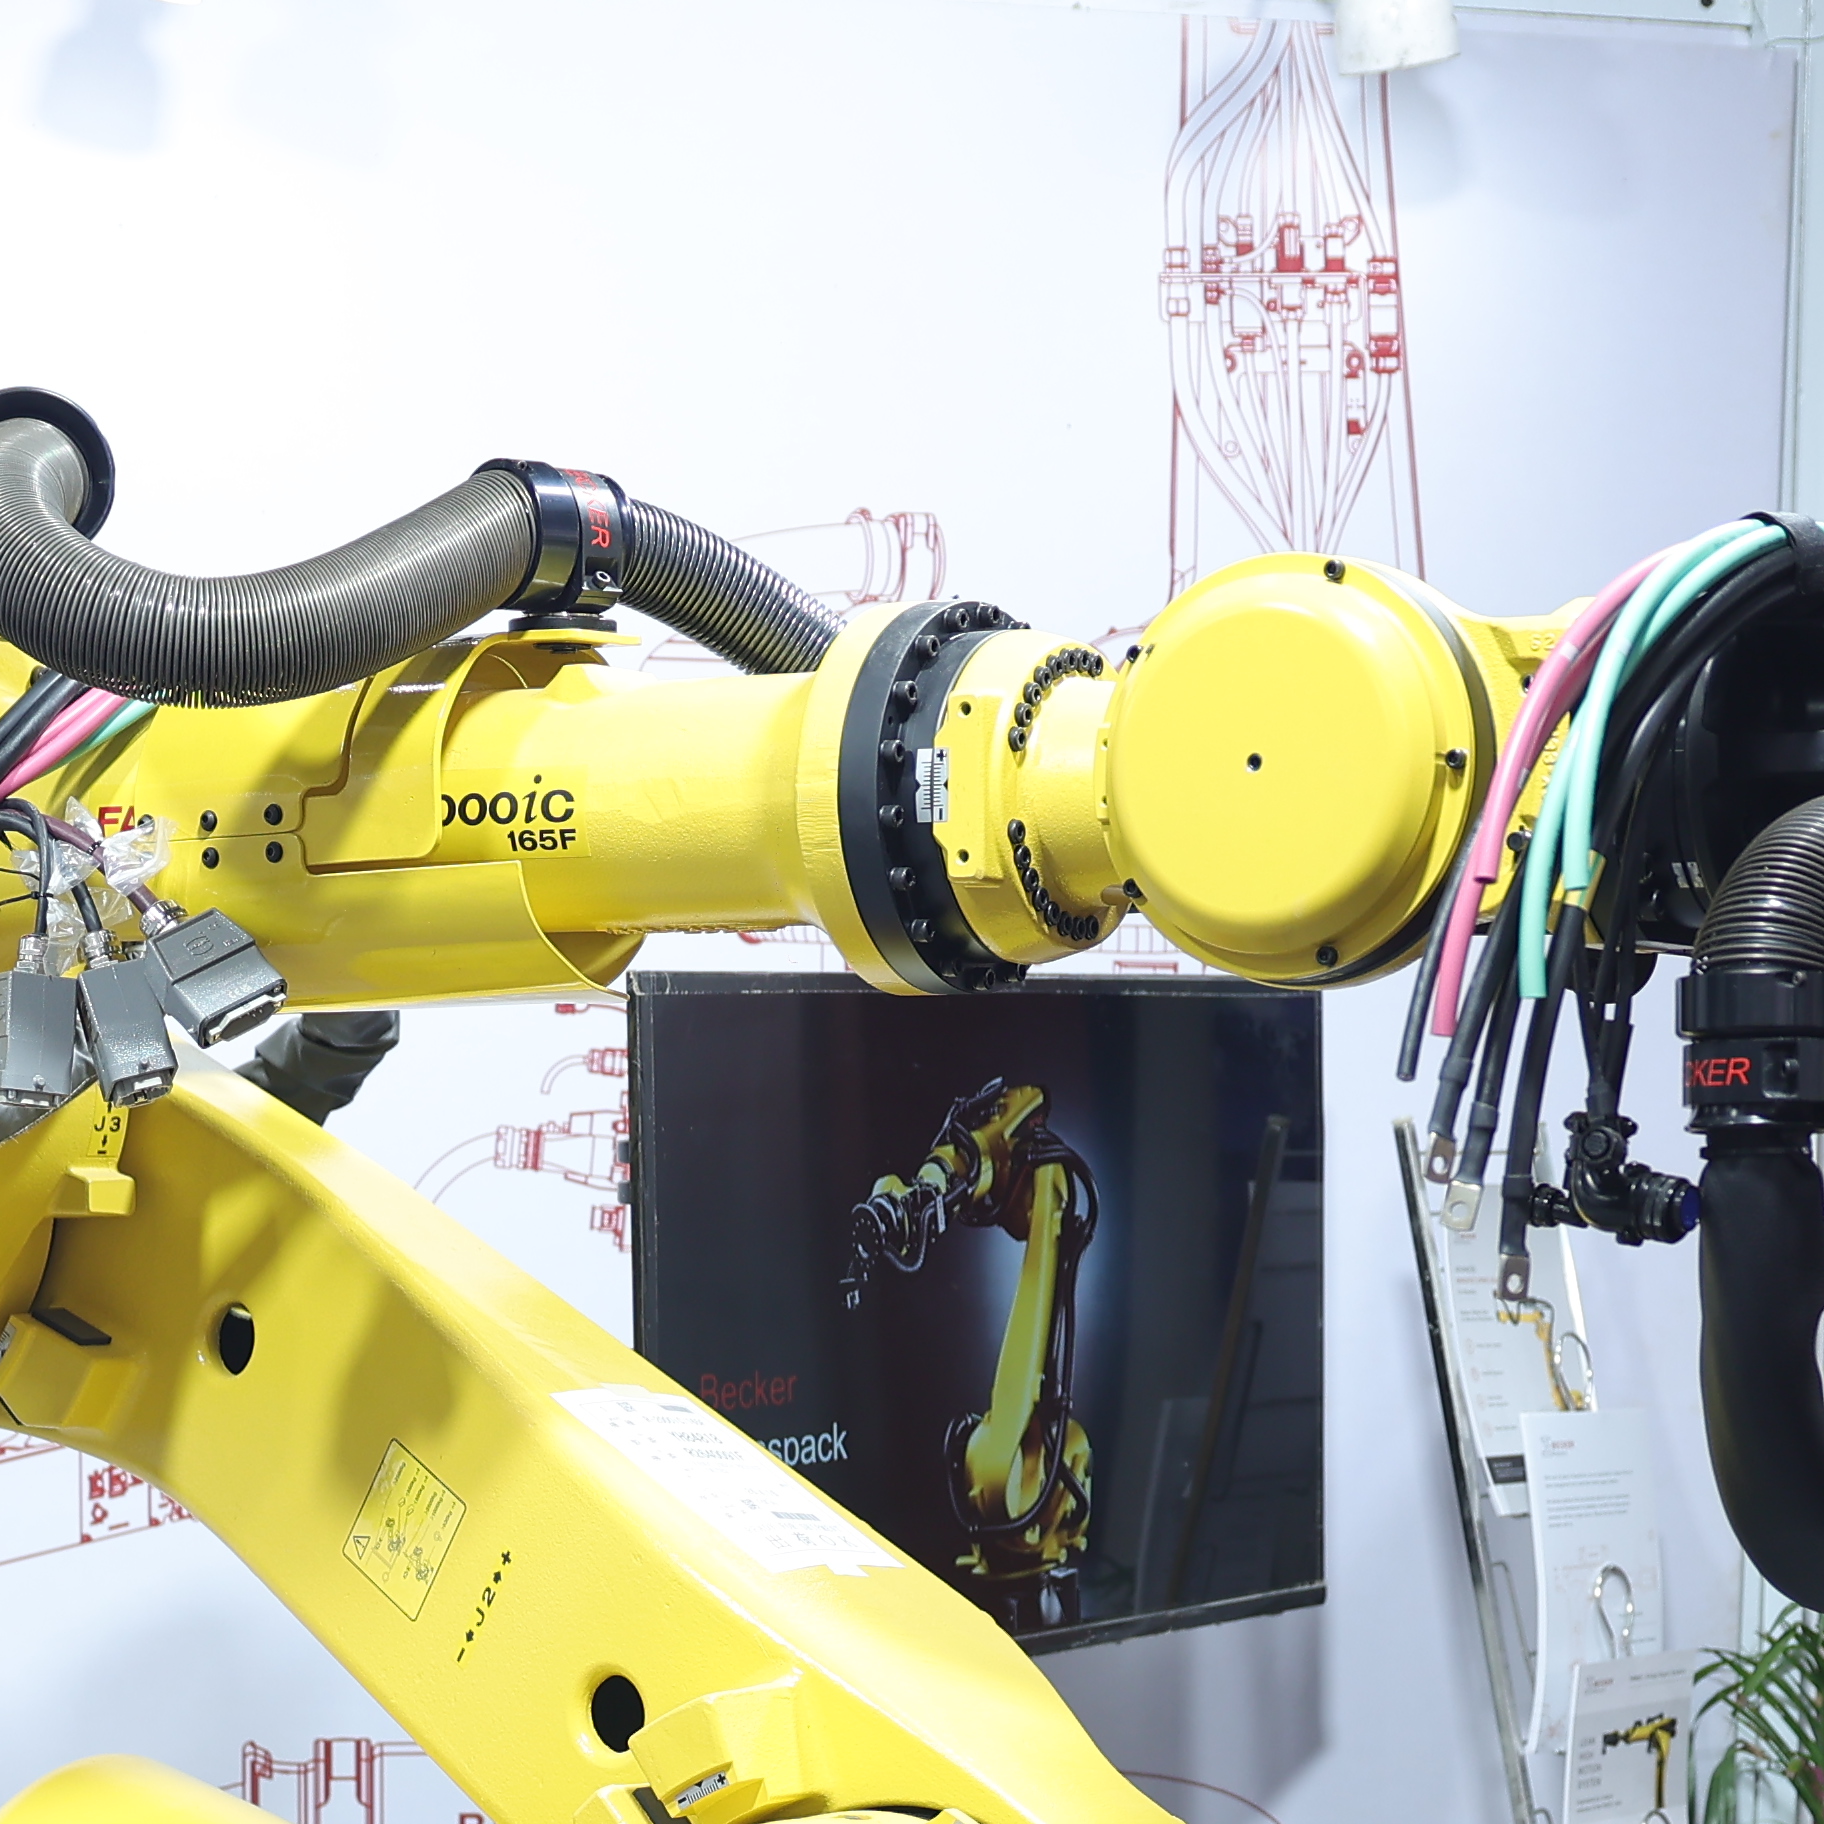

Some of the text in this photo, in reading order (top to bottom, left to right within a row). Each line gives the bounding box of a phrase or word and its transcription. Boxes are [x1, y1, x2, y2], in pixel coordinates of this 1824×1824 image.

[507, 828, 576, 852] 165F
[94, 1116, 121, 1132] J3
[700, 1369, 798, 1411] Becker
[476, 1586, 496, 1627] J2
